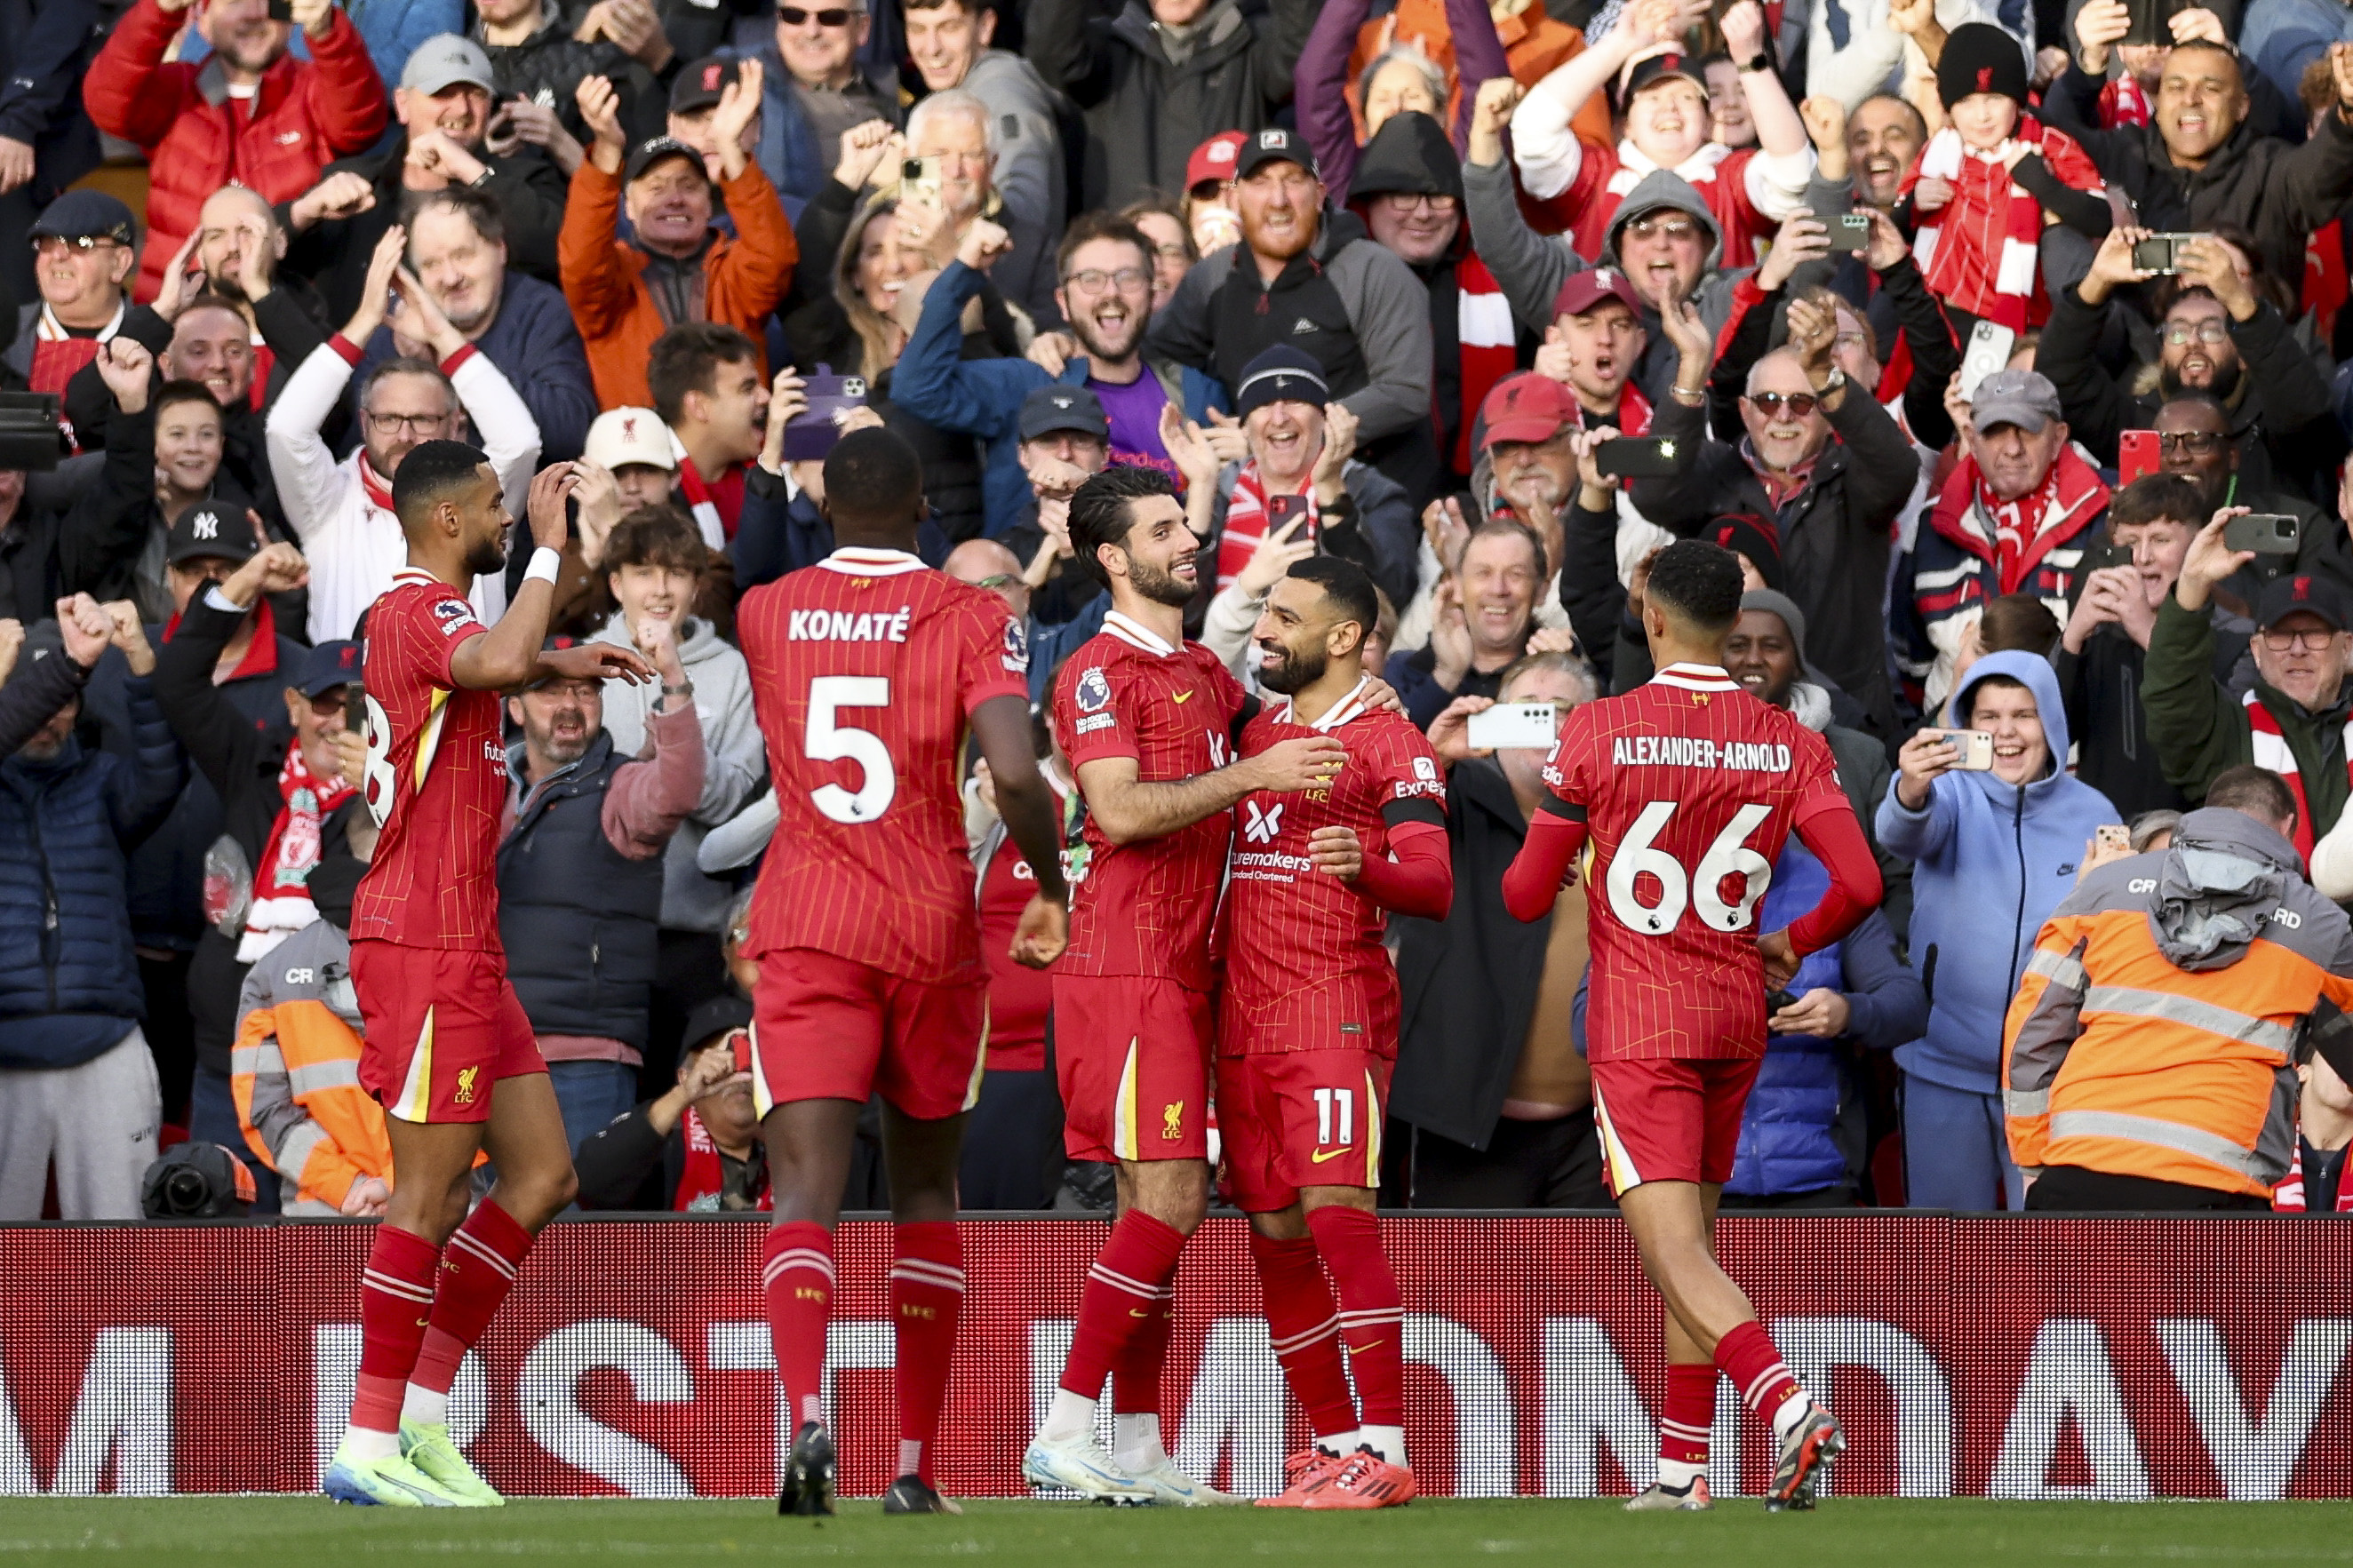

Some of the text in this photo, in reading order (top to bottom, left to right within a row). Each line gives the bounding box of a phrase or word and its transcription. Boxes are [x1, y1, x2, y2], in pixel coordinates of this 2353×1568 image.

[788, 605, 911, 644] KONATÉ
[803, 675, 897, 824] 5
[1614, 736, 1791, 774] ALEXANDER-ARNOLD
[1254, 870, 1295, 883] Chartered
[1606, 800, 1773, 935] 66
[2128, 878, 2301, 929] CR RD
[285, 967, 314, 984] CR
[1312, 1088, 1354, 1145] 11
